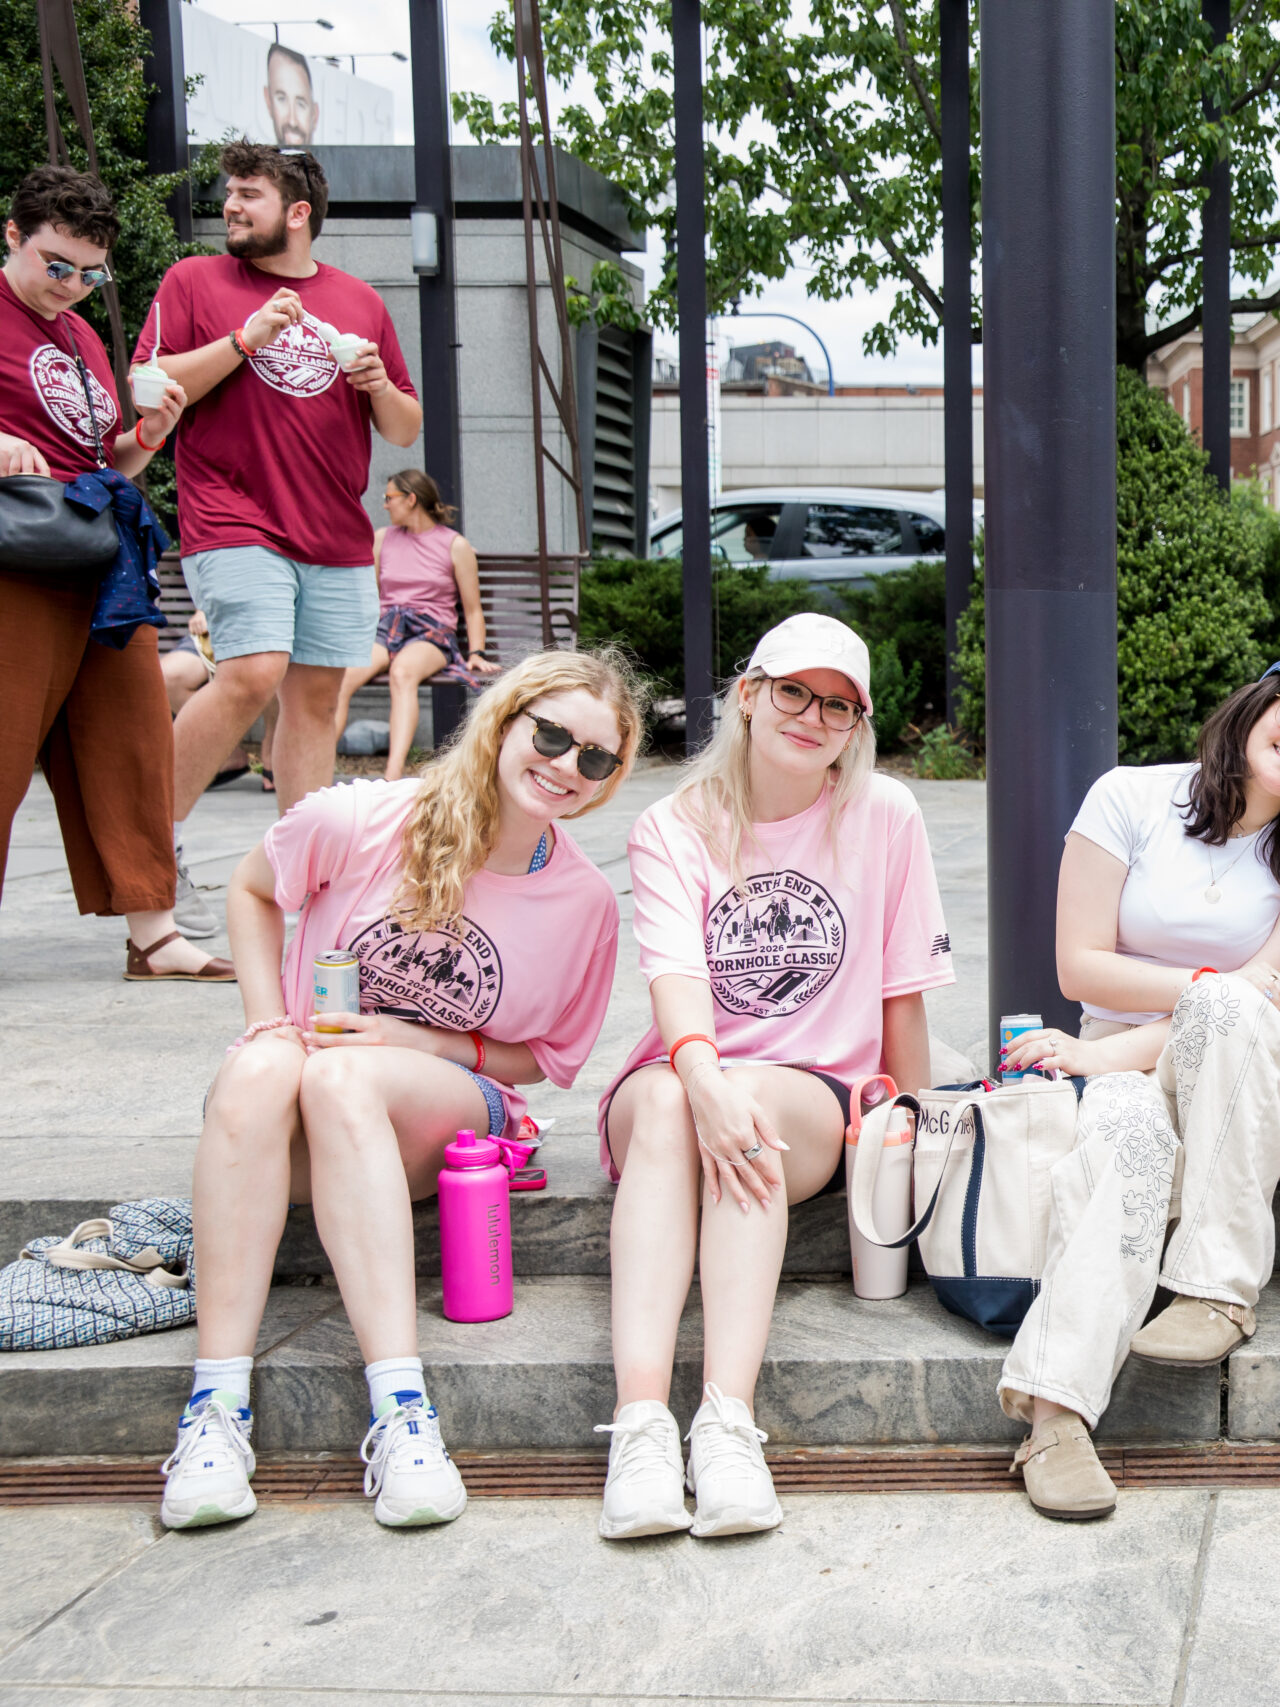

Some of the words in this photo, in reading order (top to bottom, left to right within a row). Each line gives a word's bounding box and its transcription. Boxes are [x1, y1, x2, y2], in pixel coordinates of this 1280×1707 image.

[256, 347, 298, 362] ORNHOLE
[299, 356, 336, 371] CLASSIC
[784, 875, 812, 896] END
[464, 929, 492, 960] END
[759, 944, 785, 953] 2026
[707, 955, 781, 972] CORNHOLE
[783, 952, 838, 965] CLASSIC
[359, 963, 423, 1001] ORNHOLE
[422, 994, 474, 1029] CLASSIC
[406, 979, 433, 994] 2026
[487, 1203, 502, 1286] lululemon
